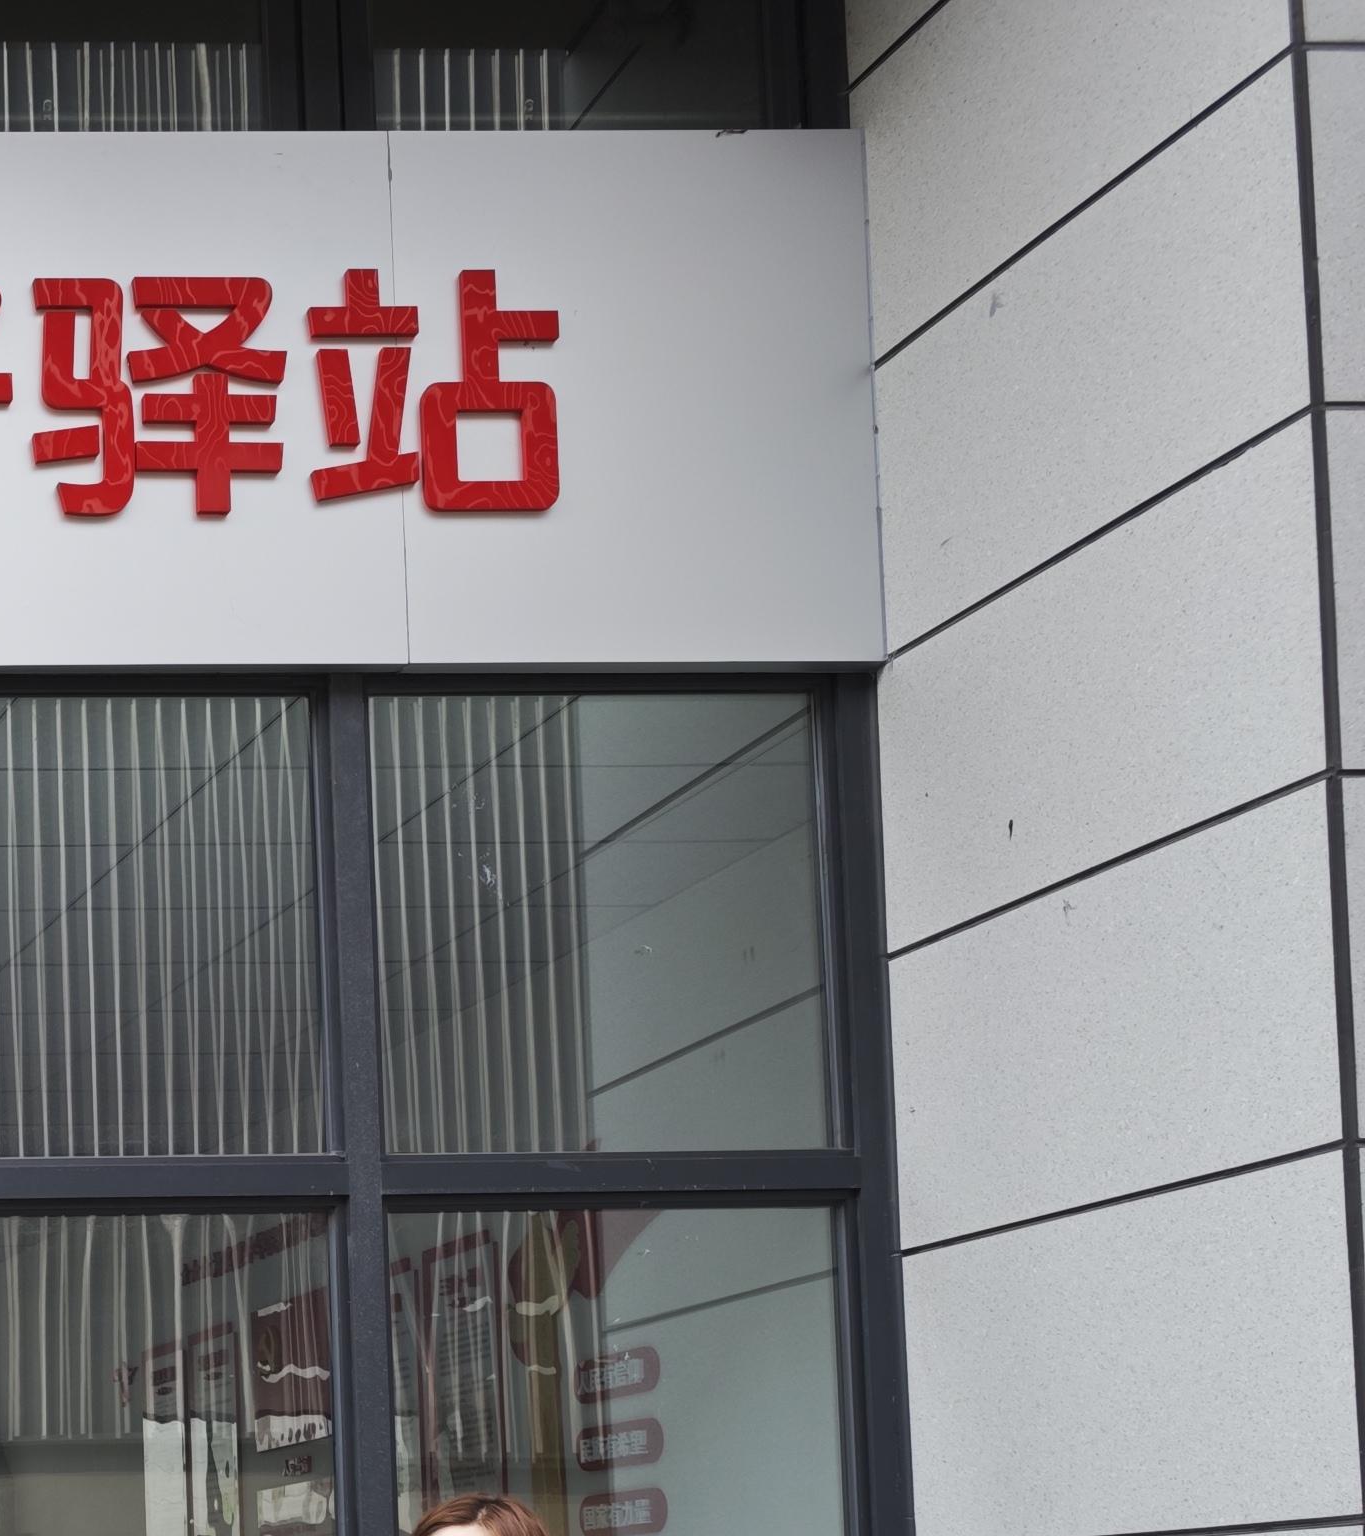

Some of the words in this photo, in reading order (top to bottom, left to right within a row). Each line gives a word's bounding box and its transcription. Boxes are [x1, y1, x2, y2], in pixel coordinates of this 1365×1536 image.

[582, 1498, 653, 1531] 国家有力量
